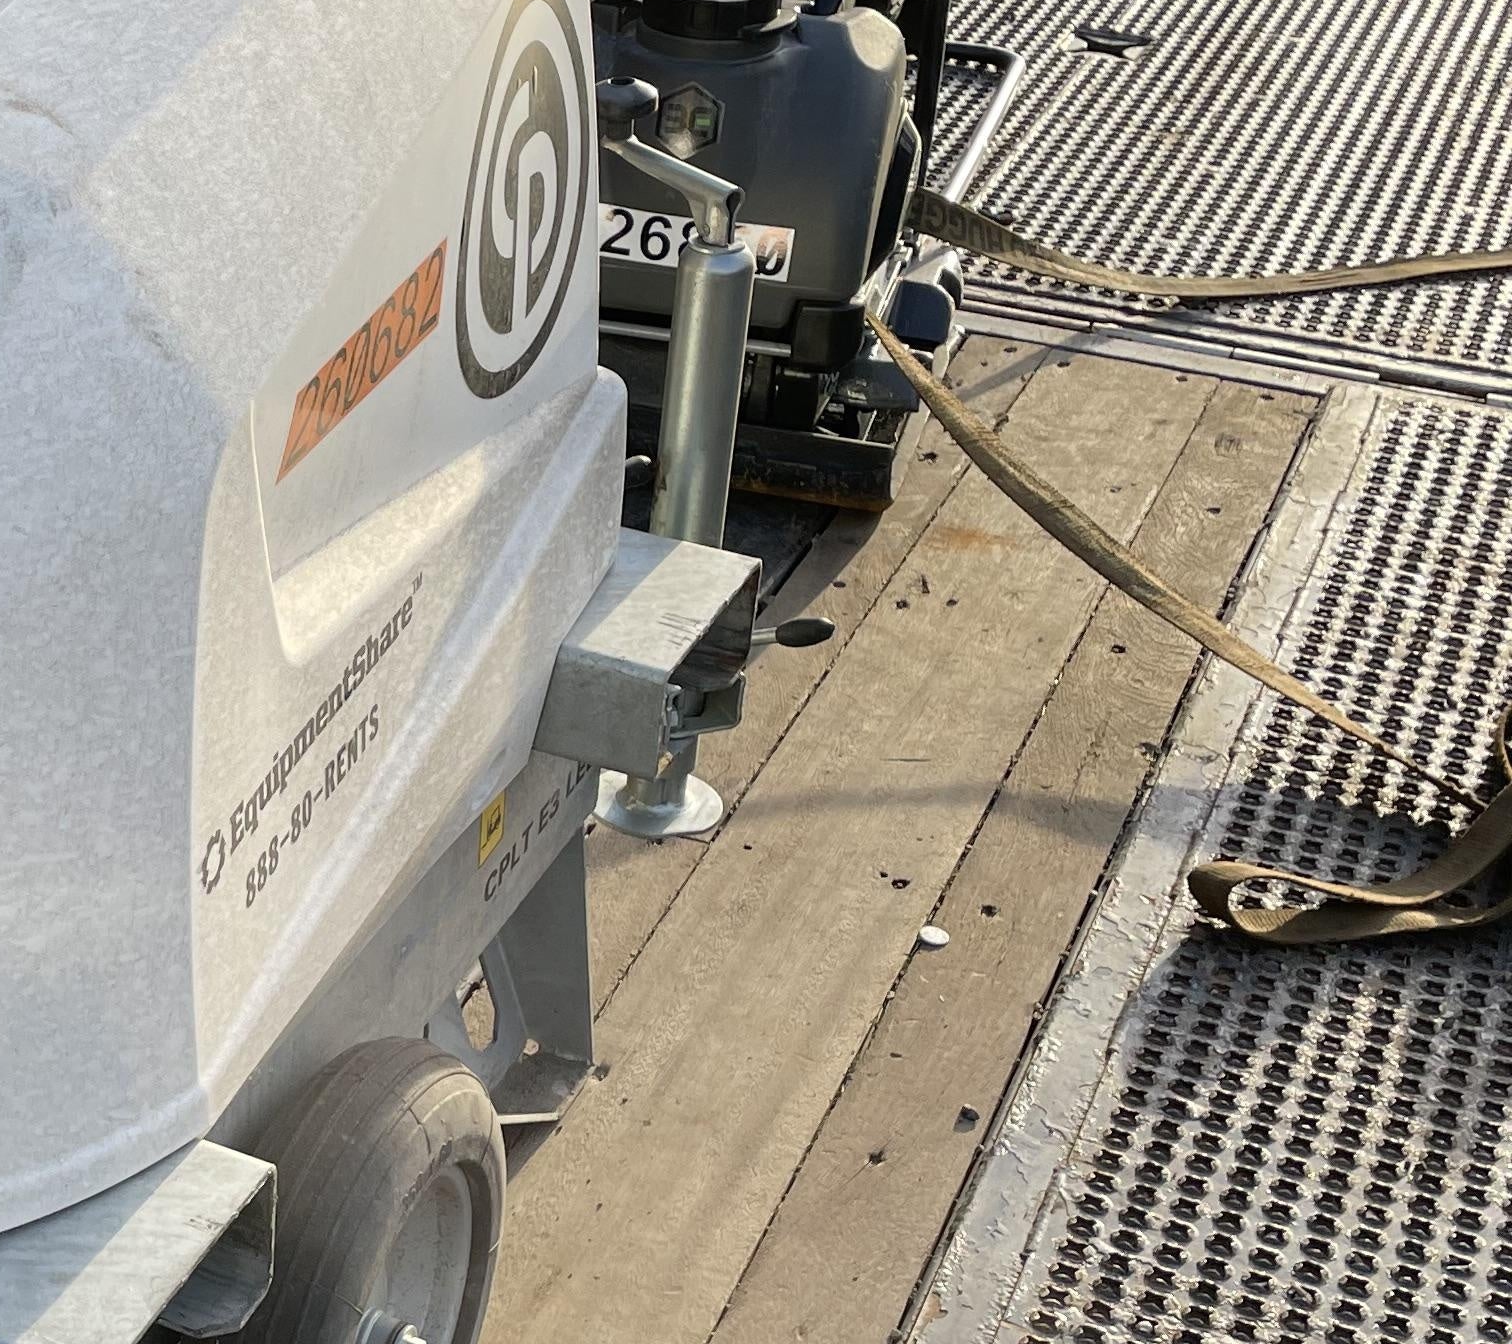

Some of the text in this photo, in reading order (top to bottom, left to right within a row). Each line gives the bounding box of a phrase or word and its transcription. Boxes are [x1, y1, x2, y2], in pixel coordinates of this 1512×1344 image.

[285, 247, 444, 472] 260682
[245, 704, 379, 909] 888-80-RENTS
[484, 762, 592, 901] CPLT E3 LE
